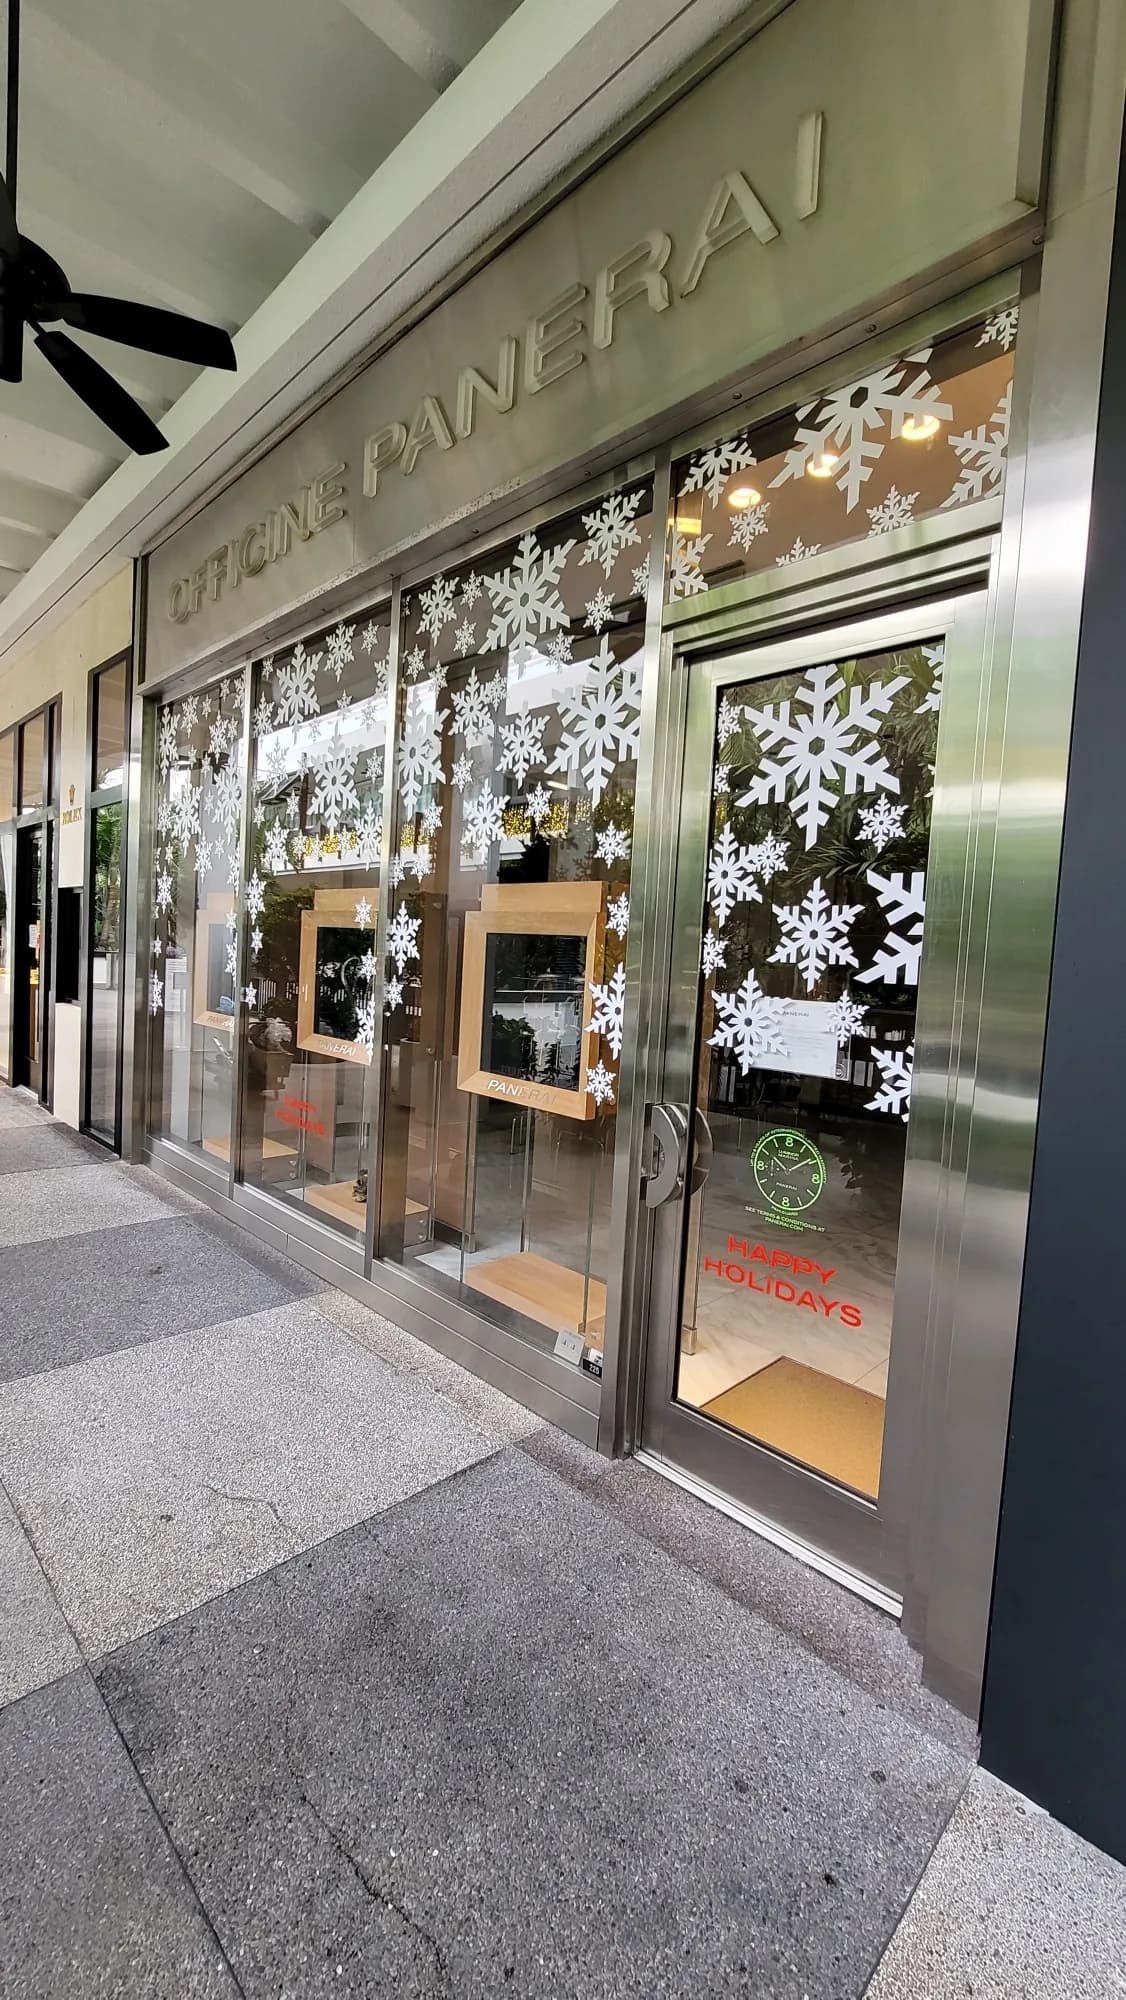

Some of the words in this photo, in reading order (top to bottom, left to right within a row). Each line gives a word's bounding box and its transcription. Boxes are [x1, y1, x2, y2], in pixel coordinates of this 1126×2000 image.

[167, 461, 348, 624] OFFICINE
[361, 110, 824, 498] PANERAI
[487, 1079, 557, 1105] PANERAI
[785, 1136, 794, 1147] 8
[757, 1160, 765, 1171] 8
[811, 1173, 820, 1184] 8
[781, 1196, 790, 1207] 8
[727, 1233, 838, 1286] HAPPY
[703, 1255, 863, 1329] HOLIDAYS
